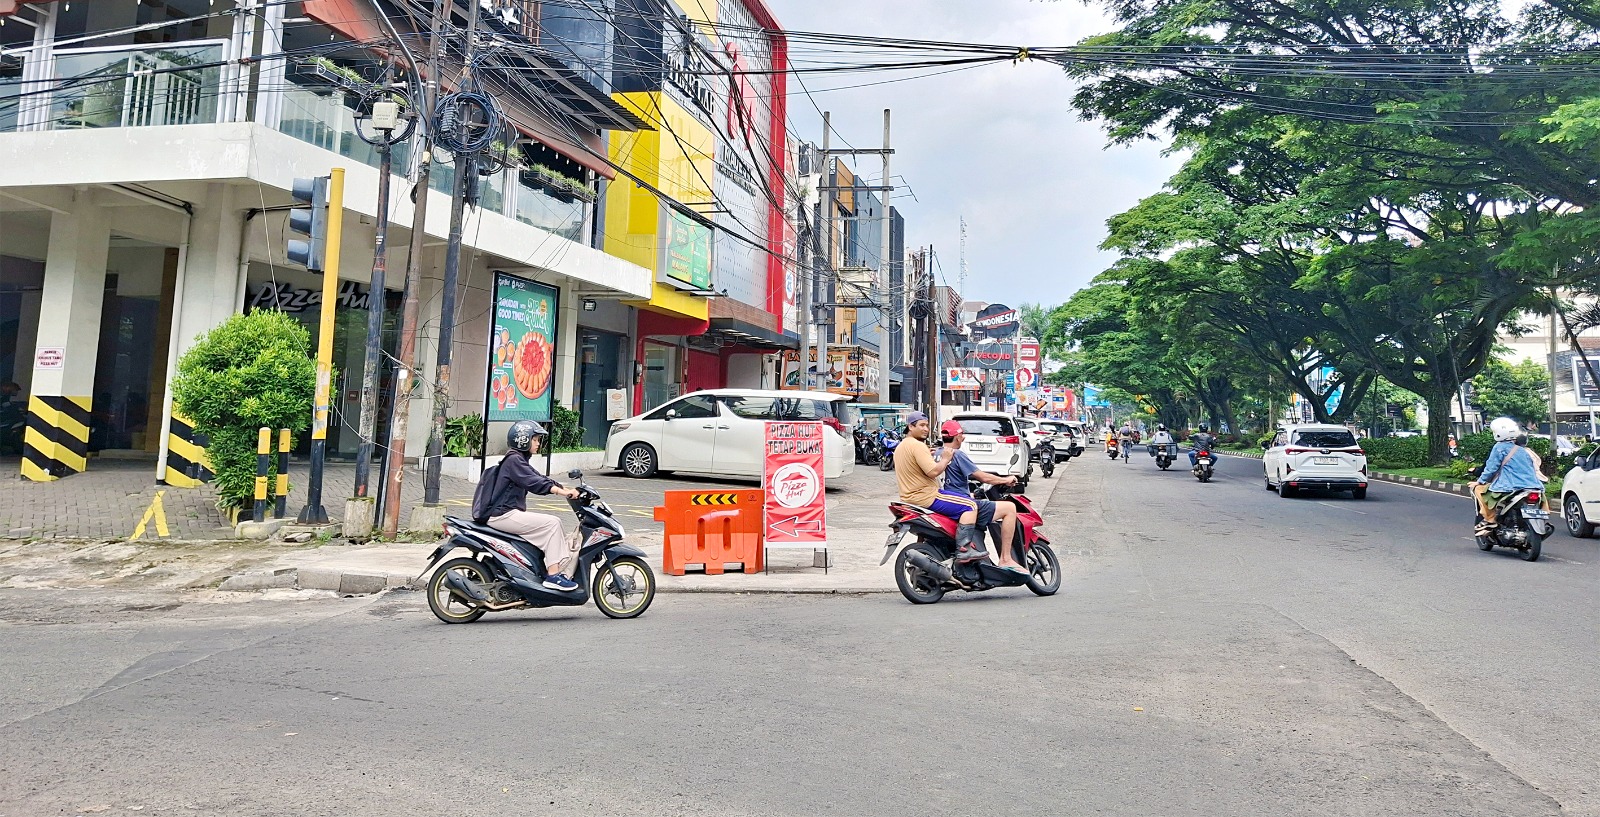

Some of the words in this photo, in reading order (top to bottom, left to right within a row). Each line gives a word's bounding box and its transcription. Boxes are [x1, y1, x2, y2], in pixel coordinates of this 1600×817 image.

[250, 281, 323, 311] Pizza
[498, 309, 511, 319] GOOD
[771, 424, 795, 438] PIZZA
[798, 424, 816, 438] HUT
[768, 441, 794, 454] TETAP
[796, 441, 821, 454] BUKA
[780, 481, 807, 493] Pizza
[785, 489, 805, 500] Hut
